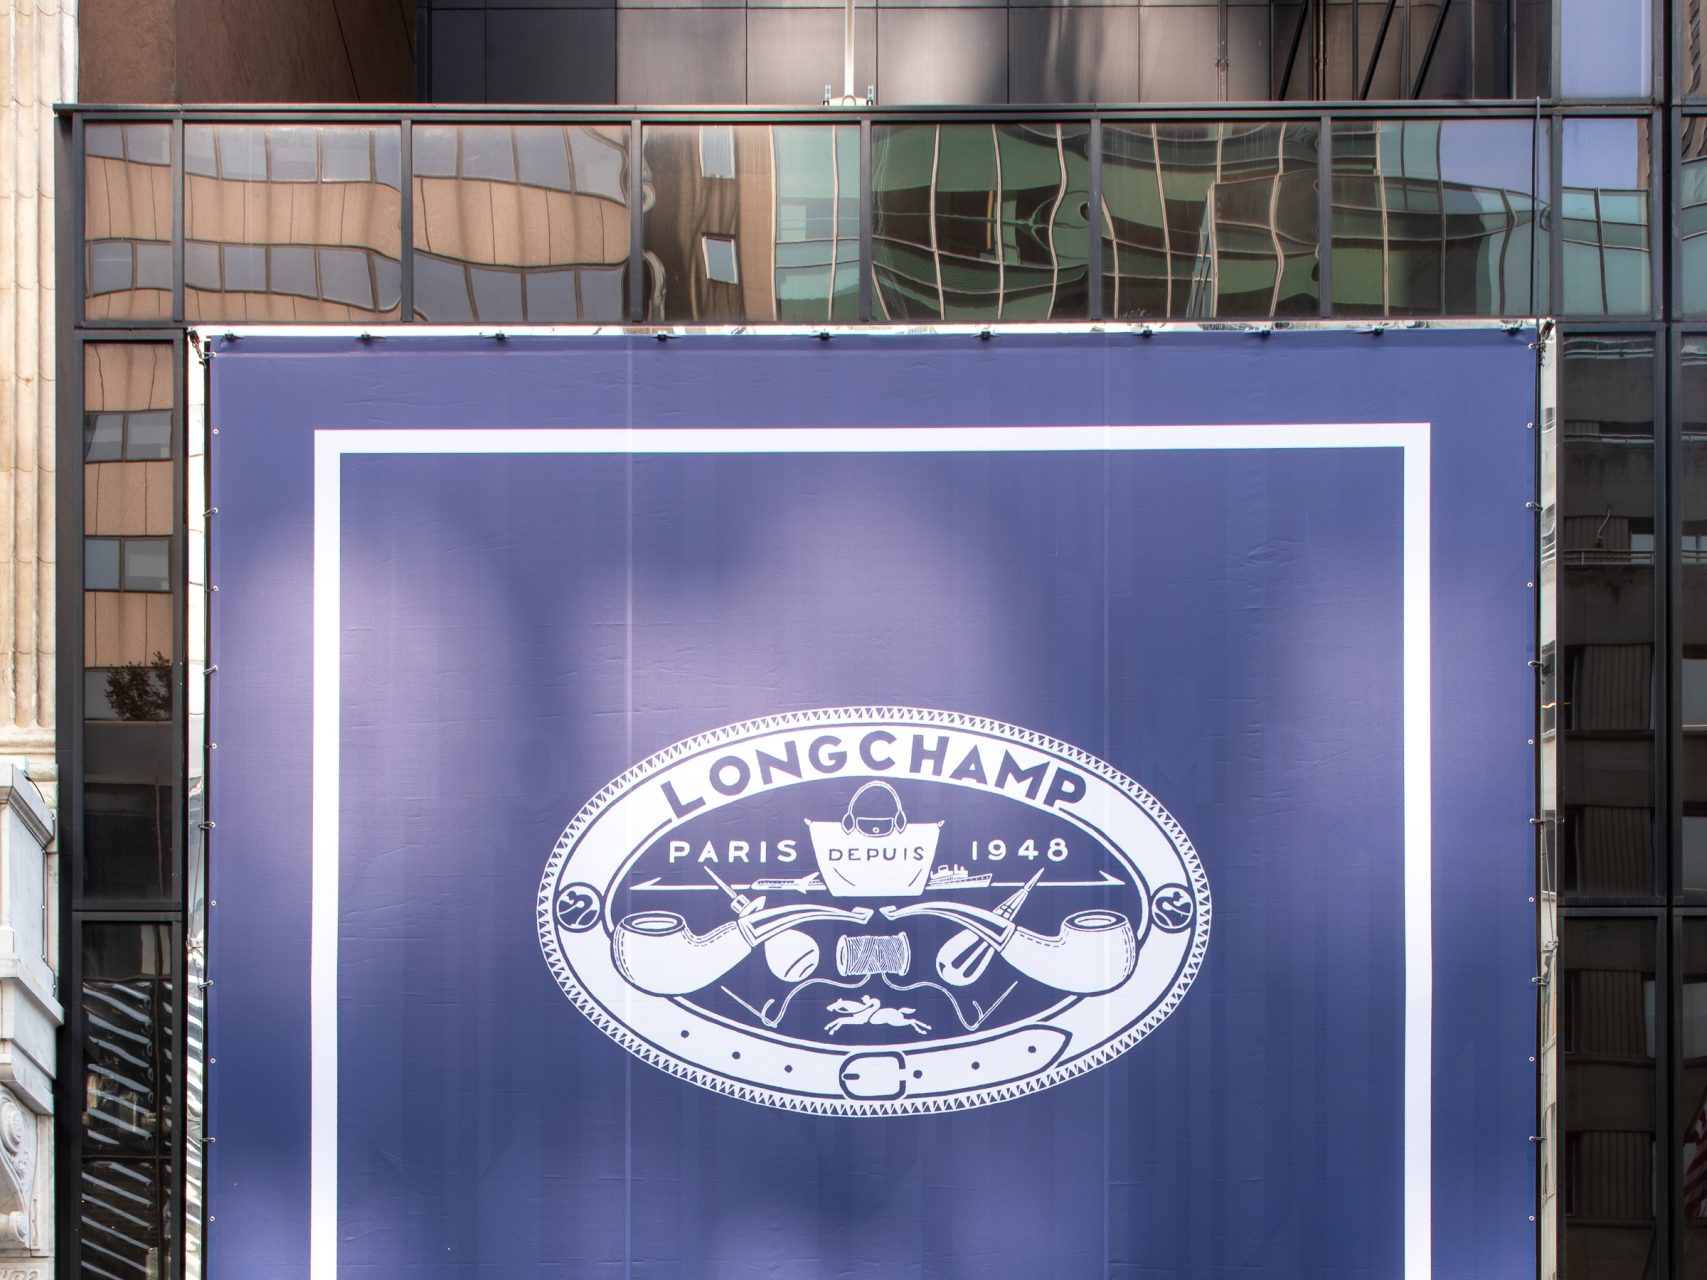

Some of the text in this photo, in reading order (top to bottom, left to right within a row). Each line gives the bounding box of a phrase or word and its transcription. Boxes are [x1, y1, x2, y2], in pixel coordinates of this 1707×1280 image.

[660, 730, 1087, 820] LONGCHAMP
[669, 838, 1069, 864] PARIS DEPUIS 1948
